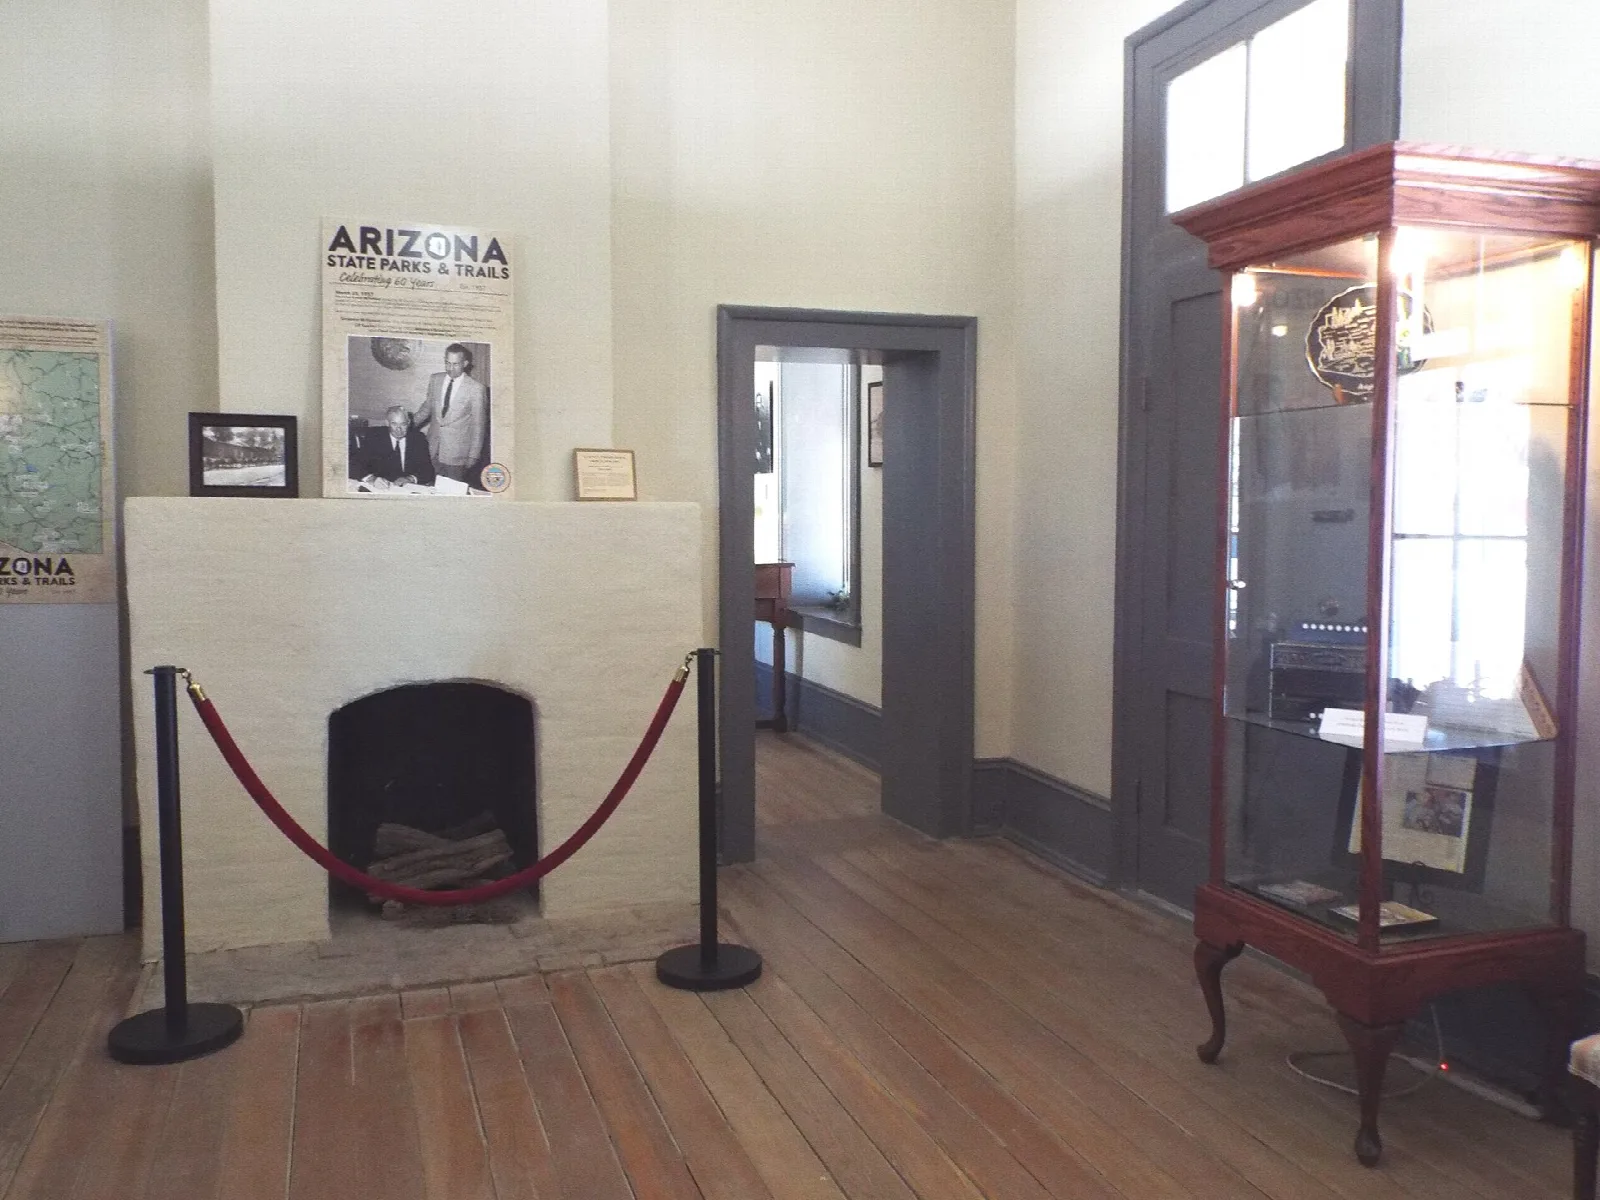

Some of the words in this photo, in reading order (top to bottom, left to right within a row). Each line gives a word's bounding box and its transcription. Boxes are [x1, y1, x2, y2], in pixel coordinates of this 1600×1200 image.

[328, 225, 508, 265] ARIZONA
[327, 255, 376, 270] STATE
[380, 258, 431, 274] PARKS
[438, 262, 449, 275] &
[455, 263, 510, 280] TRAILS
[339, 272, 392, 289] Celebrating
[394, 276, 407, 286] 60
[409, 276, 435, 290] Years
[22, 577, 31, 586] &
[35, 577, 75, 586] TRAILS
